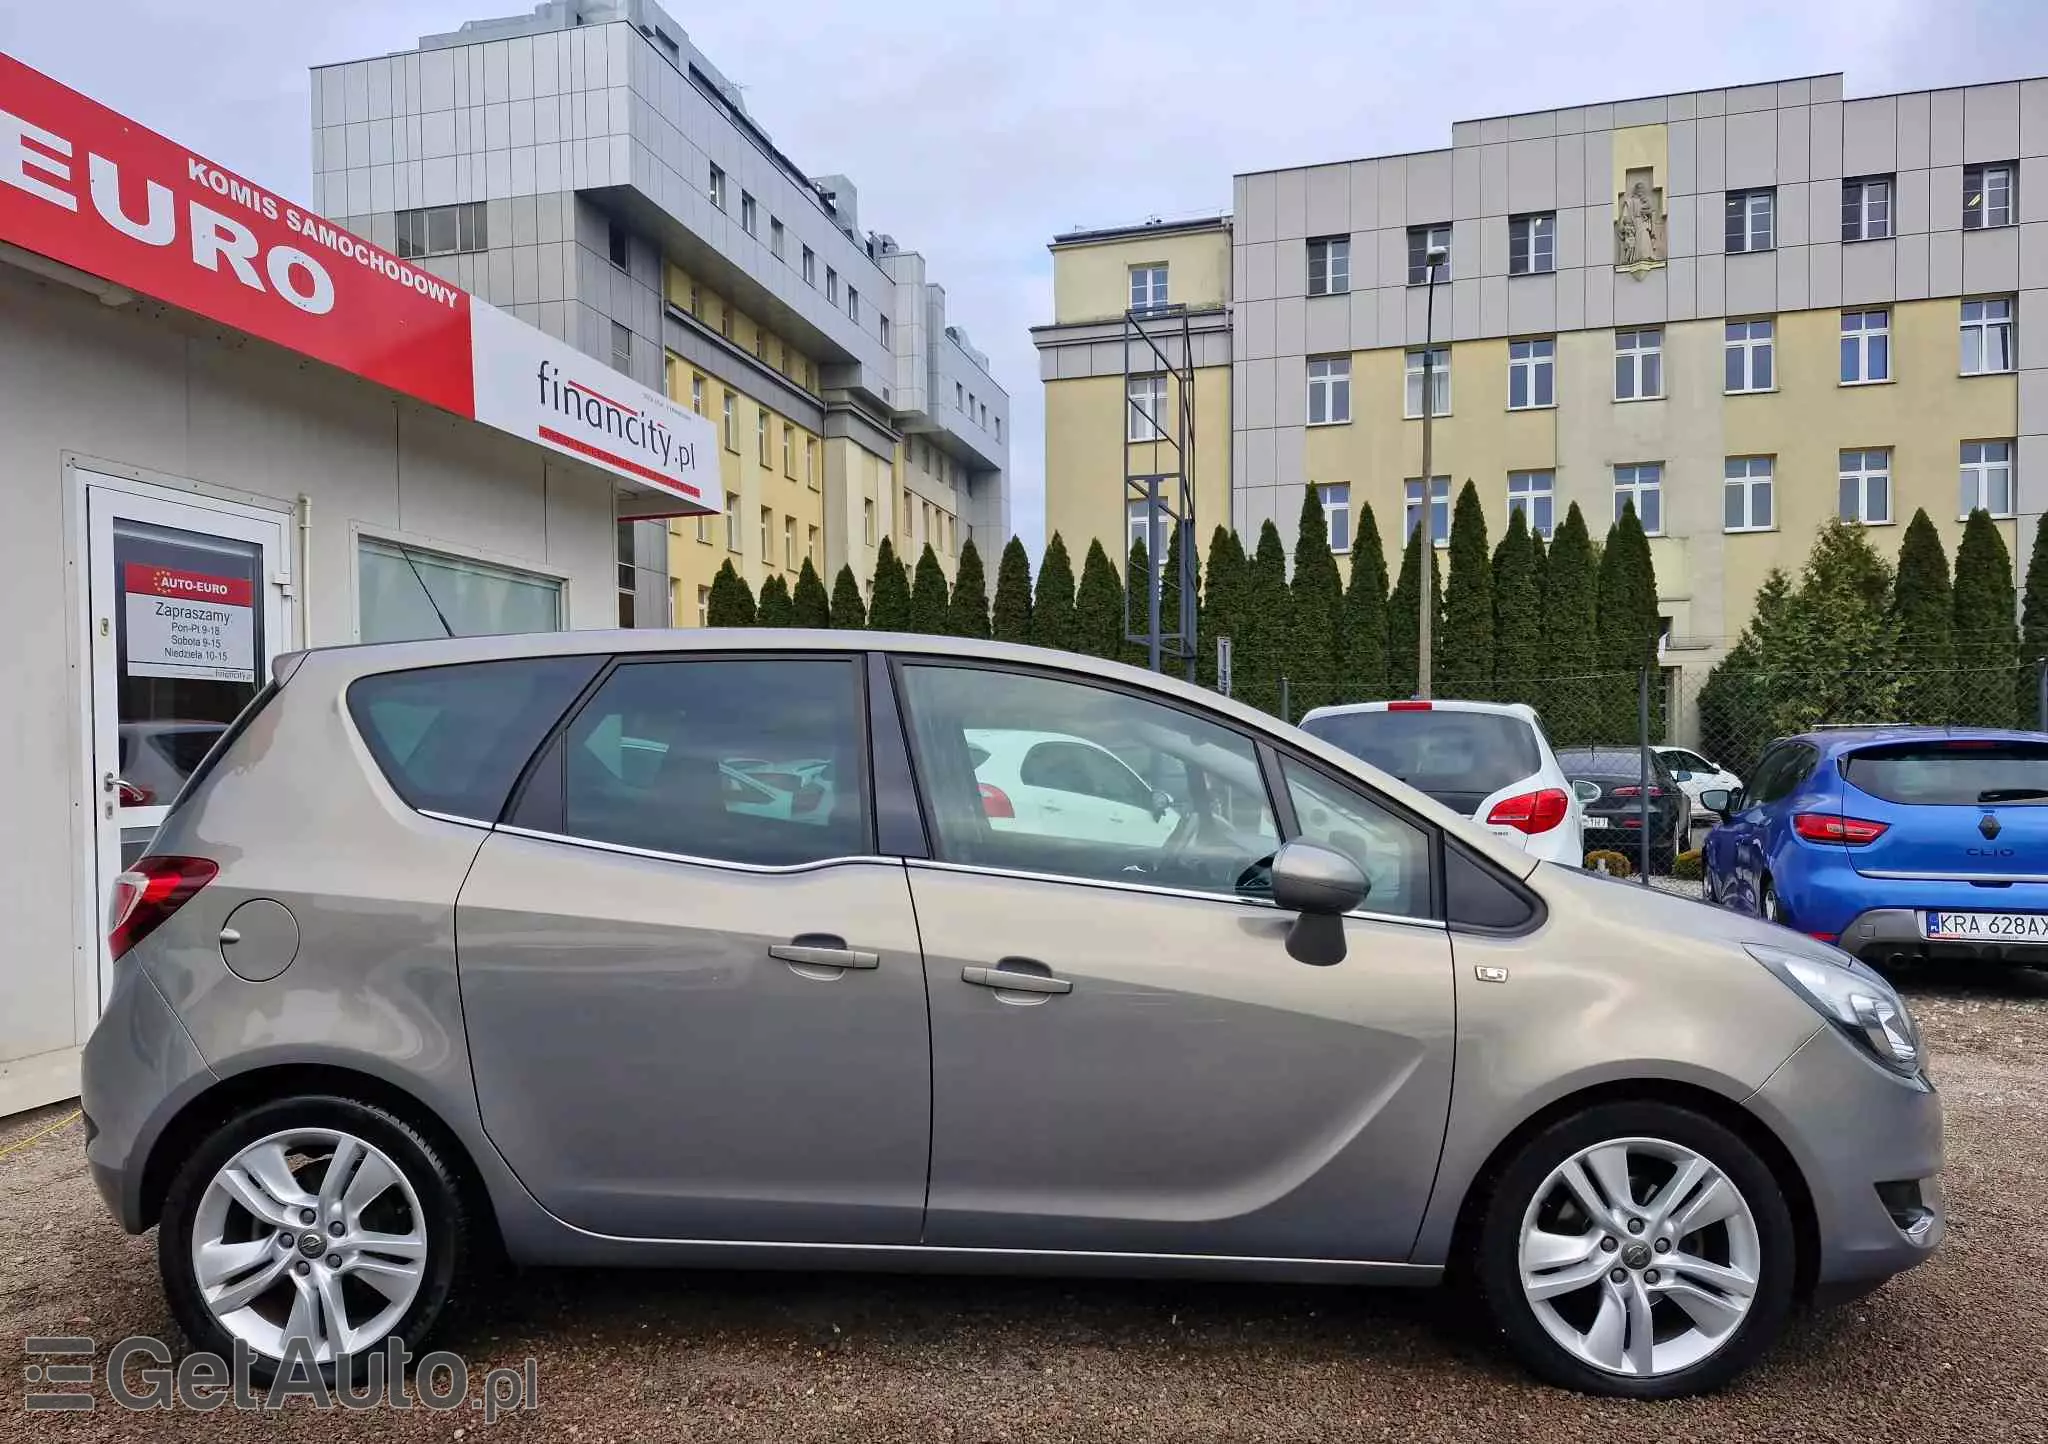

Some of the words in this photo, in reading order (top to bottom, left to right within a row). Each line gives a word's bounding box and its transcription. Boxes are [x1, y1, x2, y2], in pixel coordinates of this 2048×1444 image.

[188, 157, 278, 221] KOMIS
[286, 208, 458, 308] SAMOCHODOWY
[537, 360, 696, 473] financity.pl
[161, 576, 228, 595] AUTO-EURO
[170, 634, 201, 647] Sobota
[202, 638, 222, 649] 9-15
[164, 647, 203, 660] Niedziela
[205, 650, 228, 662] 10-15
[1965, 848, 2015, 857] CLIO
[1940, 914, 1981, 934] KRA
